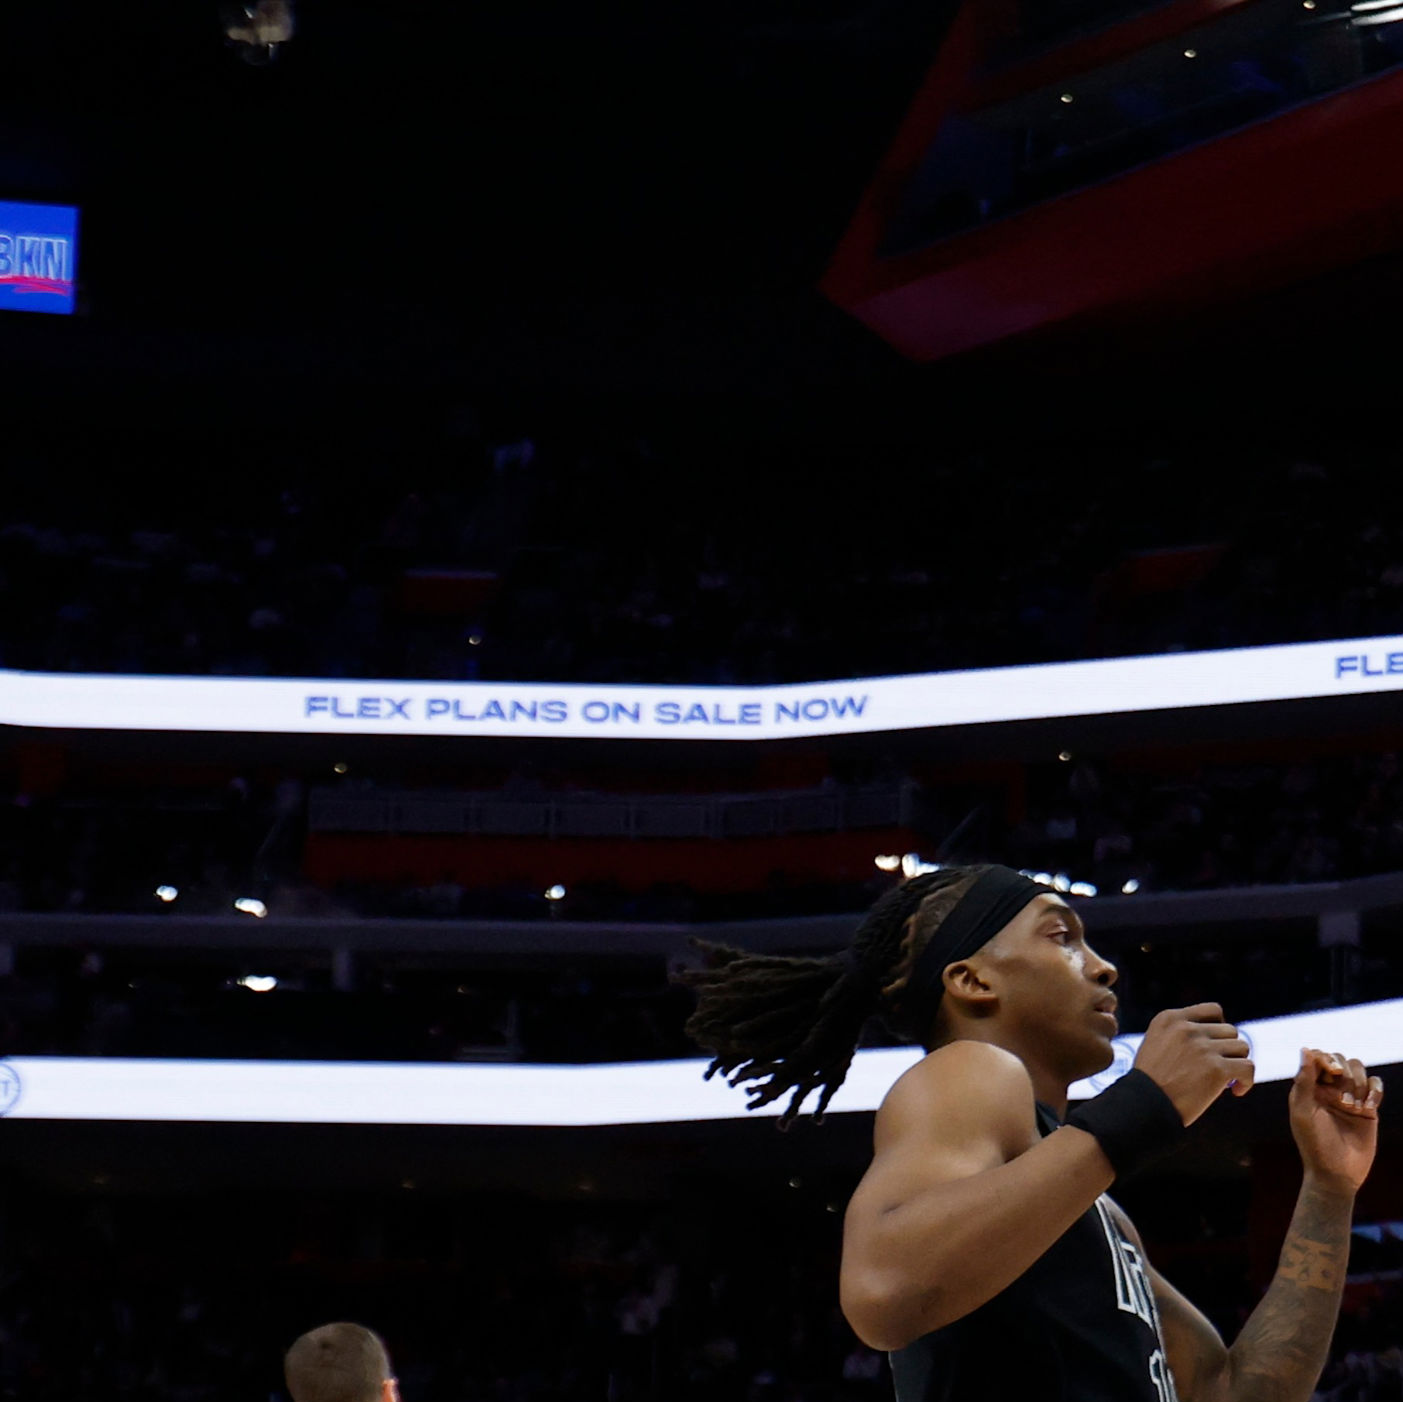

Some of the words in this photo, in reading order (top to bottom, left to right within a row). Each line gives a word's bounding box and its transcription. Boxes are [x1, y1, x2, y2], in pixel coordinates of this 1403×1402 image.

[304, 695, 411, 720] FLEX
[425, 697, 567, 723] PLANS
[580, 700, 641, 724] ON
[653, 701, 763, 725] SALE
[774, 695, 869, 721] NOW
